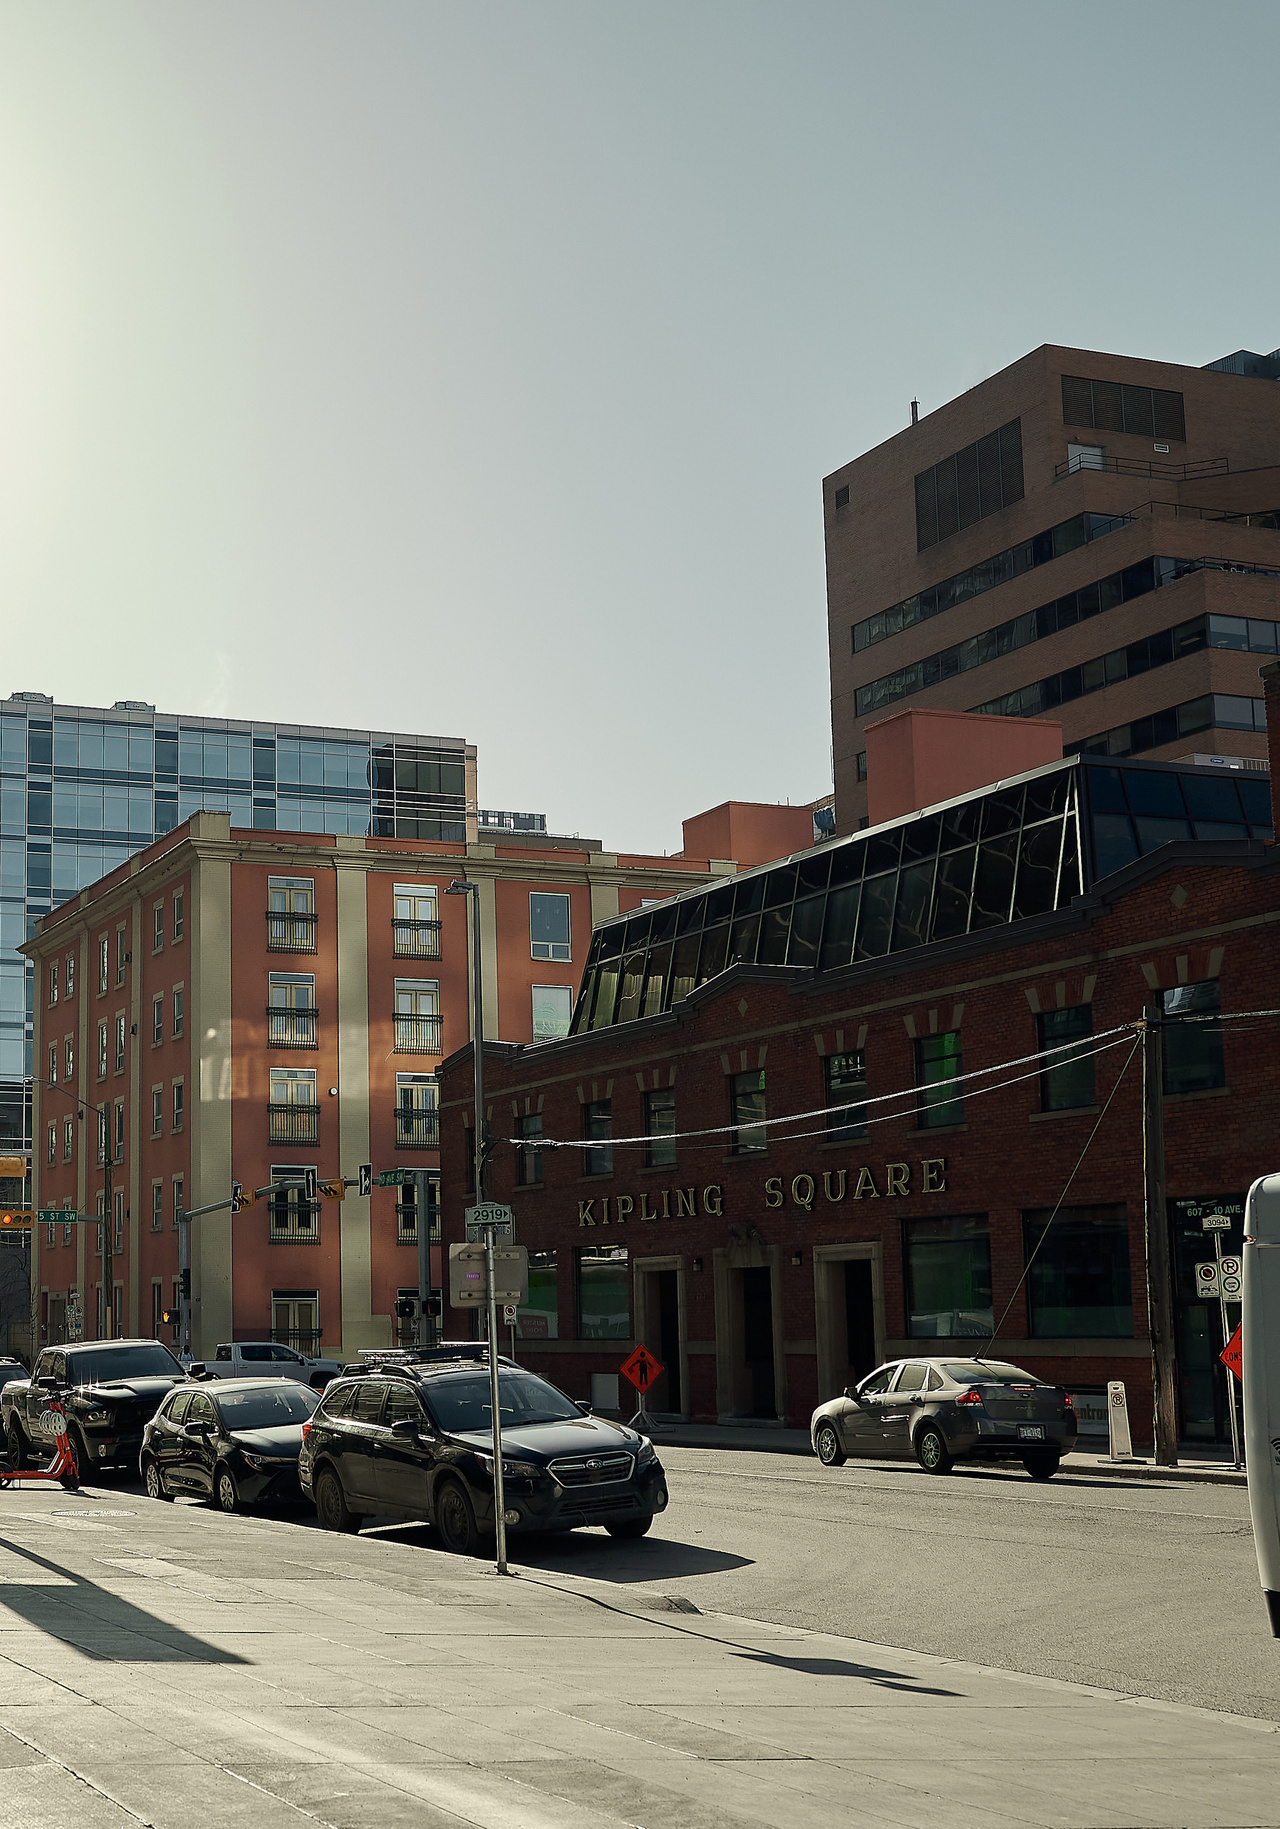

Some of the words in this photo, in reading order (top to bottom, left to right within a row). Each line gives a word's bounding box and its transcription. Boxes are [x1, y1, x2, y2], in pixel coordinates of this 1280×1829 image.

[577, 1184, 724, 1228] KIPLING
[764, 1157, 947, 1212] SQUARE
[473, 1208, 503, 1221] 2919
[1187, 1207, 1202, 1216] 607
[1213, 1206, 1224, 1215] 10
[1224, 1204, 1244, 1214] AVE.
[38, 1212, 45, 1220] 5
[50, 1212, 60, 1220] ST
[64, 1212, 76, 1221] SW
[1207, 1218, 1226, 1227] 3094
[1224, 1351, 1242, 1362] CONS
